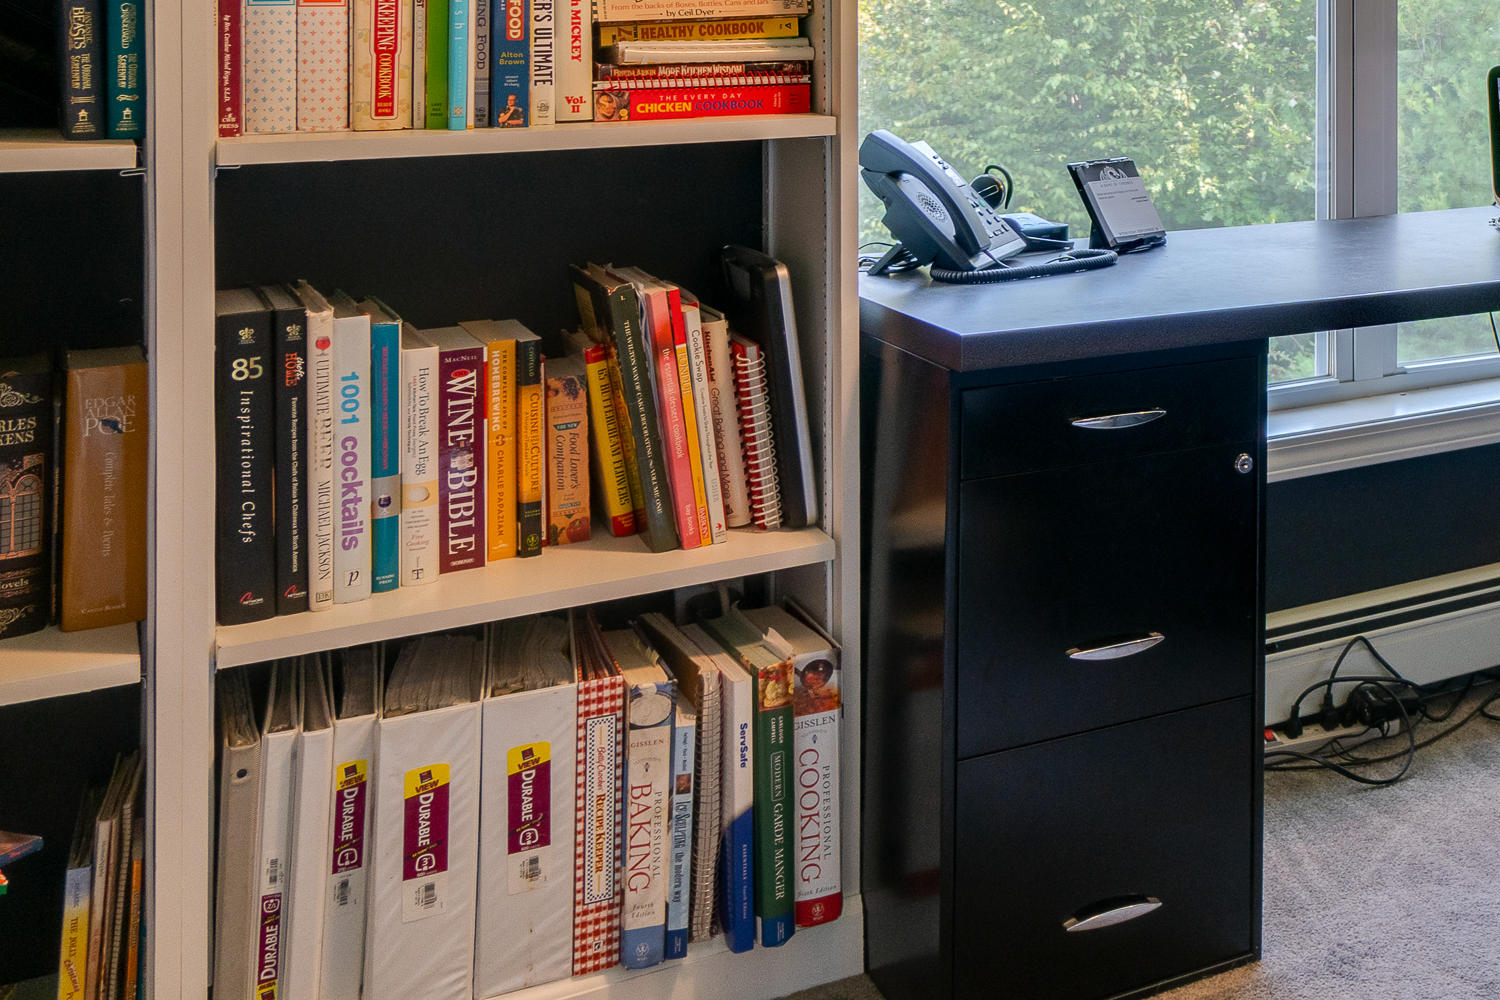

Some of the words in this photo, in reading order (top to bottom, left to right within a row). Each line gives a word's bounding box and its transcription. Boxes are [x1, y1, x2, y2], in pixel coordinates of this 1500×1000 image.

[508, 0, 523, 39] FOOD
[611, 3, 631, 11] From
[695, 8, 716, 18] Dyer
[71, 5, 87, 50] BEASTS
[570, 9, 582, 63] MICKEY
[640, 25, 695, 40] HEALTHY
[699, 21, 765, 36] COOKBOOK
[477, 32, 488, 71] FOOD
[499, 57, 525, 66] Brown
[500, 51, 523, 59] Alton
[533, 26, 554, 87] ULTIMATE
[658, 65, 680, 77] MORE
[712, 63, 743, 74] WISDOM
[378, 52, 394, 100] COOKBOOK
[565, 95, 586, 105] Vol.
[636, 101, 692, 114] CHICKEN
[694, 99, 764, 112] COOKBOOK
[659, 94, 678, 102] THE
[683, 93, 716, 101] EVERY
[722, 91, 743, 99] DAY
[691, 329, 702, 360] Cookie
[704, 329, 716, 382] KitchenAid
[231, 356, 263, 381] 85
[285, 352, 298, 387] HOME
[315, 358, 329, 416] ULTIMATE
[418, 367, 430, 390] How
[678, 351, 692, 395] FONDUE
[694, 361, 704, 383] Swap
[85, 395, 136, 409] EDGAR
[340, 371, 360, 425] 1001
[419, 392, 430, 407] To
[446, 369, 478, 447] WINE
[491, 350, 501, 432] HOMEBREWING
[710, 387, 722, 415] Great
[0, 416, 37, 431] RLES
[419, 408, 431, 438] Break
[529, 392, 540, 434] CUISINE
[714, 417, 726, 448] Baking
[240, 391, 255, 498] Inspirational
[553, 434, 565, 491] Companion
[569, 432, 580, 454] Food
[416, 456, 429, 475] Egg
[529, 446, 540, 492] CULTURE
[568, 455, 580, 490] Lover's
[614, 459, 631, 506] FLOWERS
[317, 480, 330, 530] MICHAEL
[340, 436, 365, 551] cocktails
[447, 466, 478, 555] BIBLE
[496, 489, 504, 537] PAPAZIAN
[242, 501, 256, 544] Chefs
[318, 531, 332, 581] JACKSON
[794, 713, 837, 731] GISSLEN
[630, 738, 665, 748] GISSLEN
[739, 722, 748, 769] ServSafe
[339, 773, 365, 788] VIEW
[517, 757, 541, 770] VIEW
[772, 754, 783, 799] MODERN
[415, 779, 439, 793] VIEW
[521, 768, 536, 822] DURABLE
[341, 786, 358, 842] DURABLE
[418, 792, 434, 848] DURABLE
[596, 793, 607, 830] RECIPE
[774, 802, 784, 840] GARDE
[798, 748, 823, 885] COOKING
[822, 764, 832, 861] PROFESSIONAL
[594, 832, 605, 875] KEEPER
[627, 782, 653, 894] BAKING
[652, 791, 663, 879] PROFESSIONAL
[674, 865, 685, 888] modern
[775, 847, 785, 901] MANGER
[260, 924, 279, 981] DURABLE
